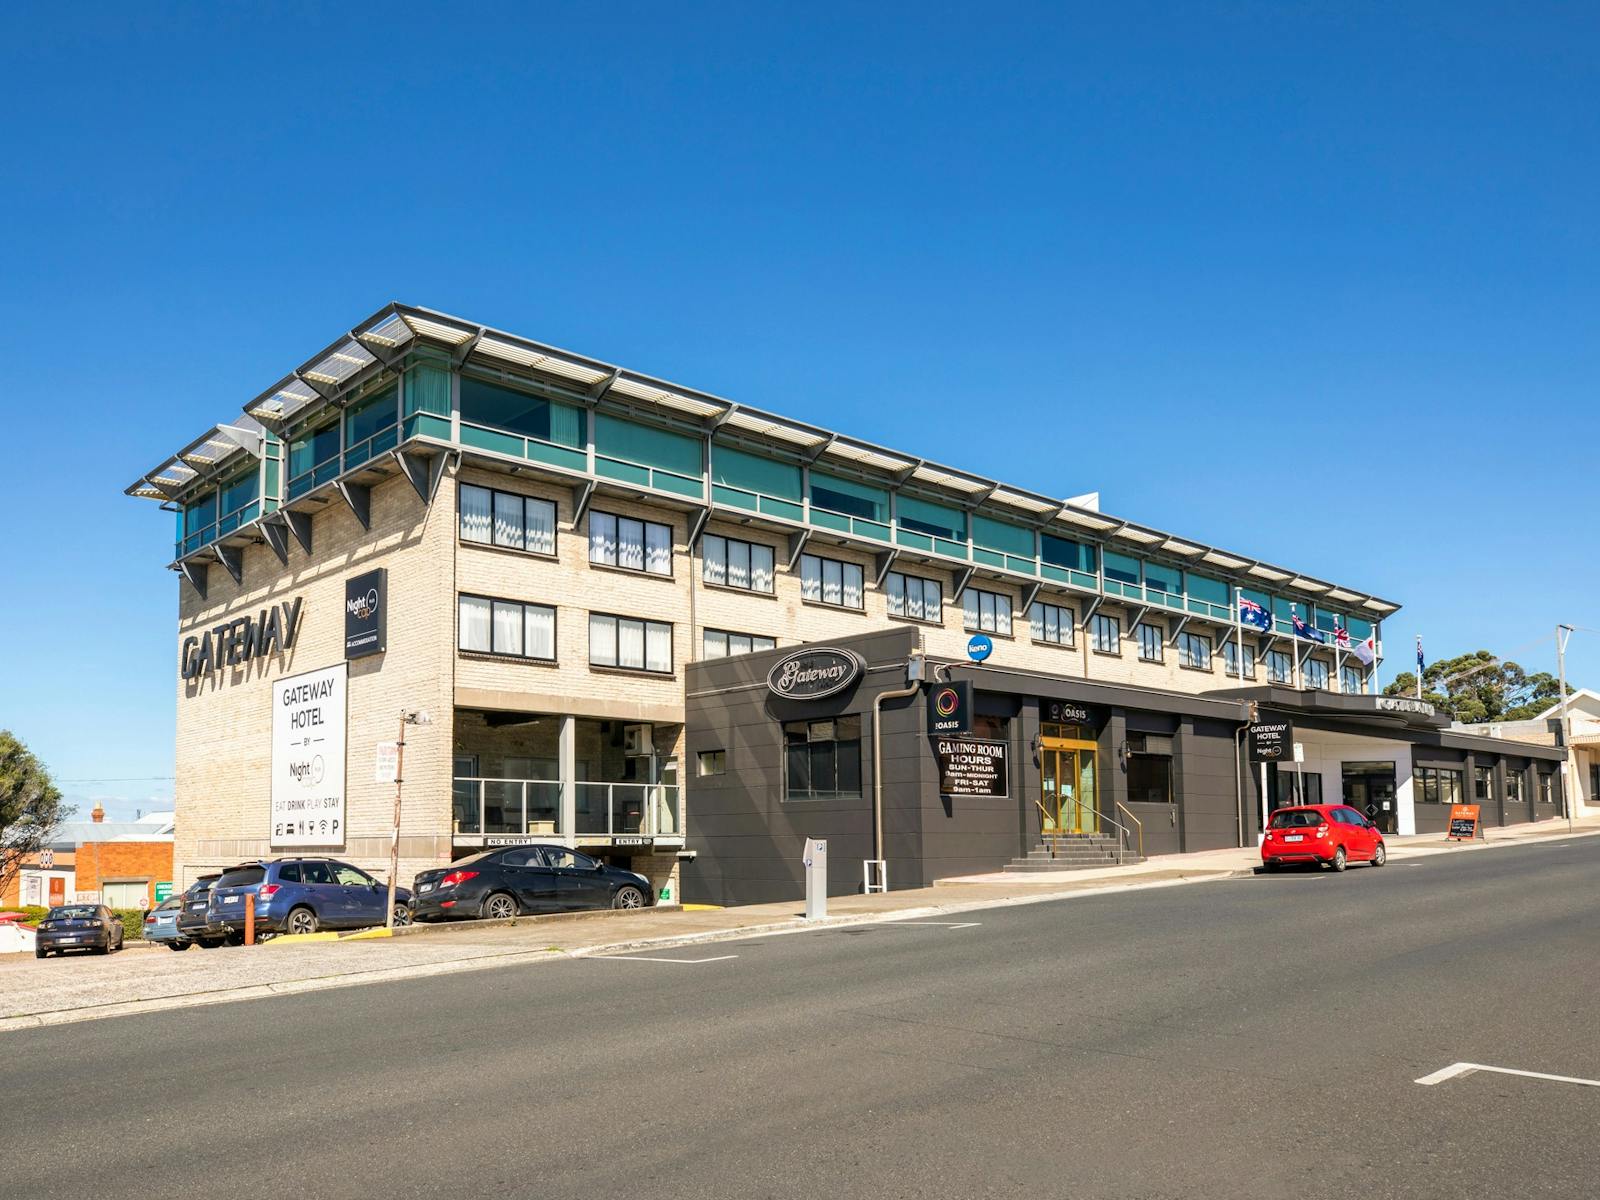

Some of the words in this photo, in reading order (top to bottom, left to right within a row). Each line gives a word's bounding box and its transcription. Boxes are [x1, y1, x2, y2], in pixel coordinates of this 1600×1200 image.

[347, 596, 366, 615] Night
[181, 597, 303, 679] GATEWAY
[777, 660, 847, 692] Gateway
[283, 678, 334, 706] GATEWAY
[291, 707, 324, 730] HOTEL
[1065, 709, 1086, 719] OASIS
[938, 721, 959, 730] OASIS
[1250, 724, 1287, 733] GATEWAY
[304, 737, 310, 746] BY
[939, 742, 976, 754] GAMING
[977, 744, 1003, 758] ROOM
[951, 755, 992, 764] HOURS
[289, 761, 310, 782] Night
[948, 764, 994, 772] SUN-THUR
[275, 801, 286, 812] EAT
[287, 800, 306, 811] DRINK
[307, 799, 322, 809] PLAY
[323, 797, 339, 808] STAY
